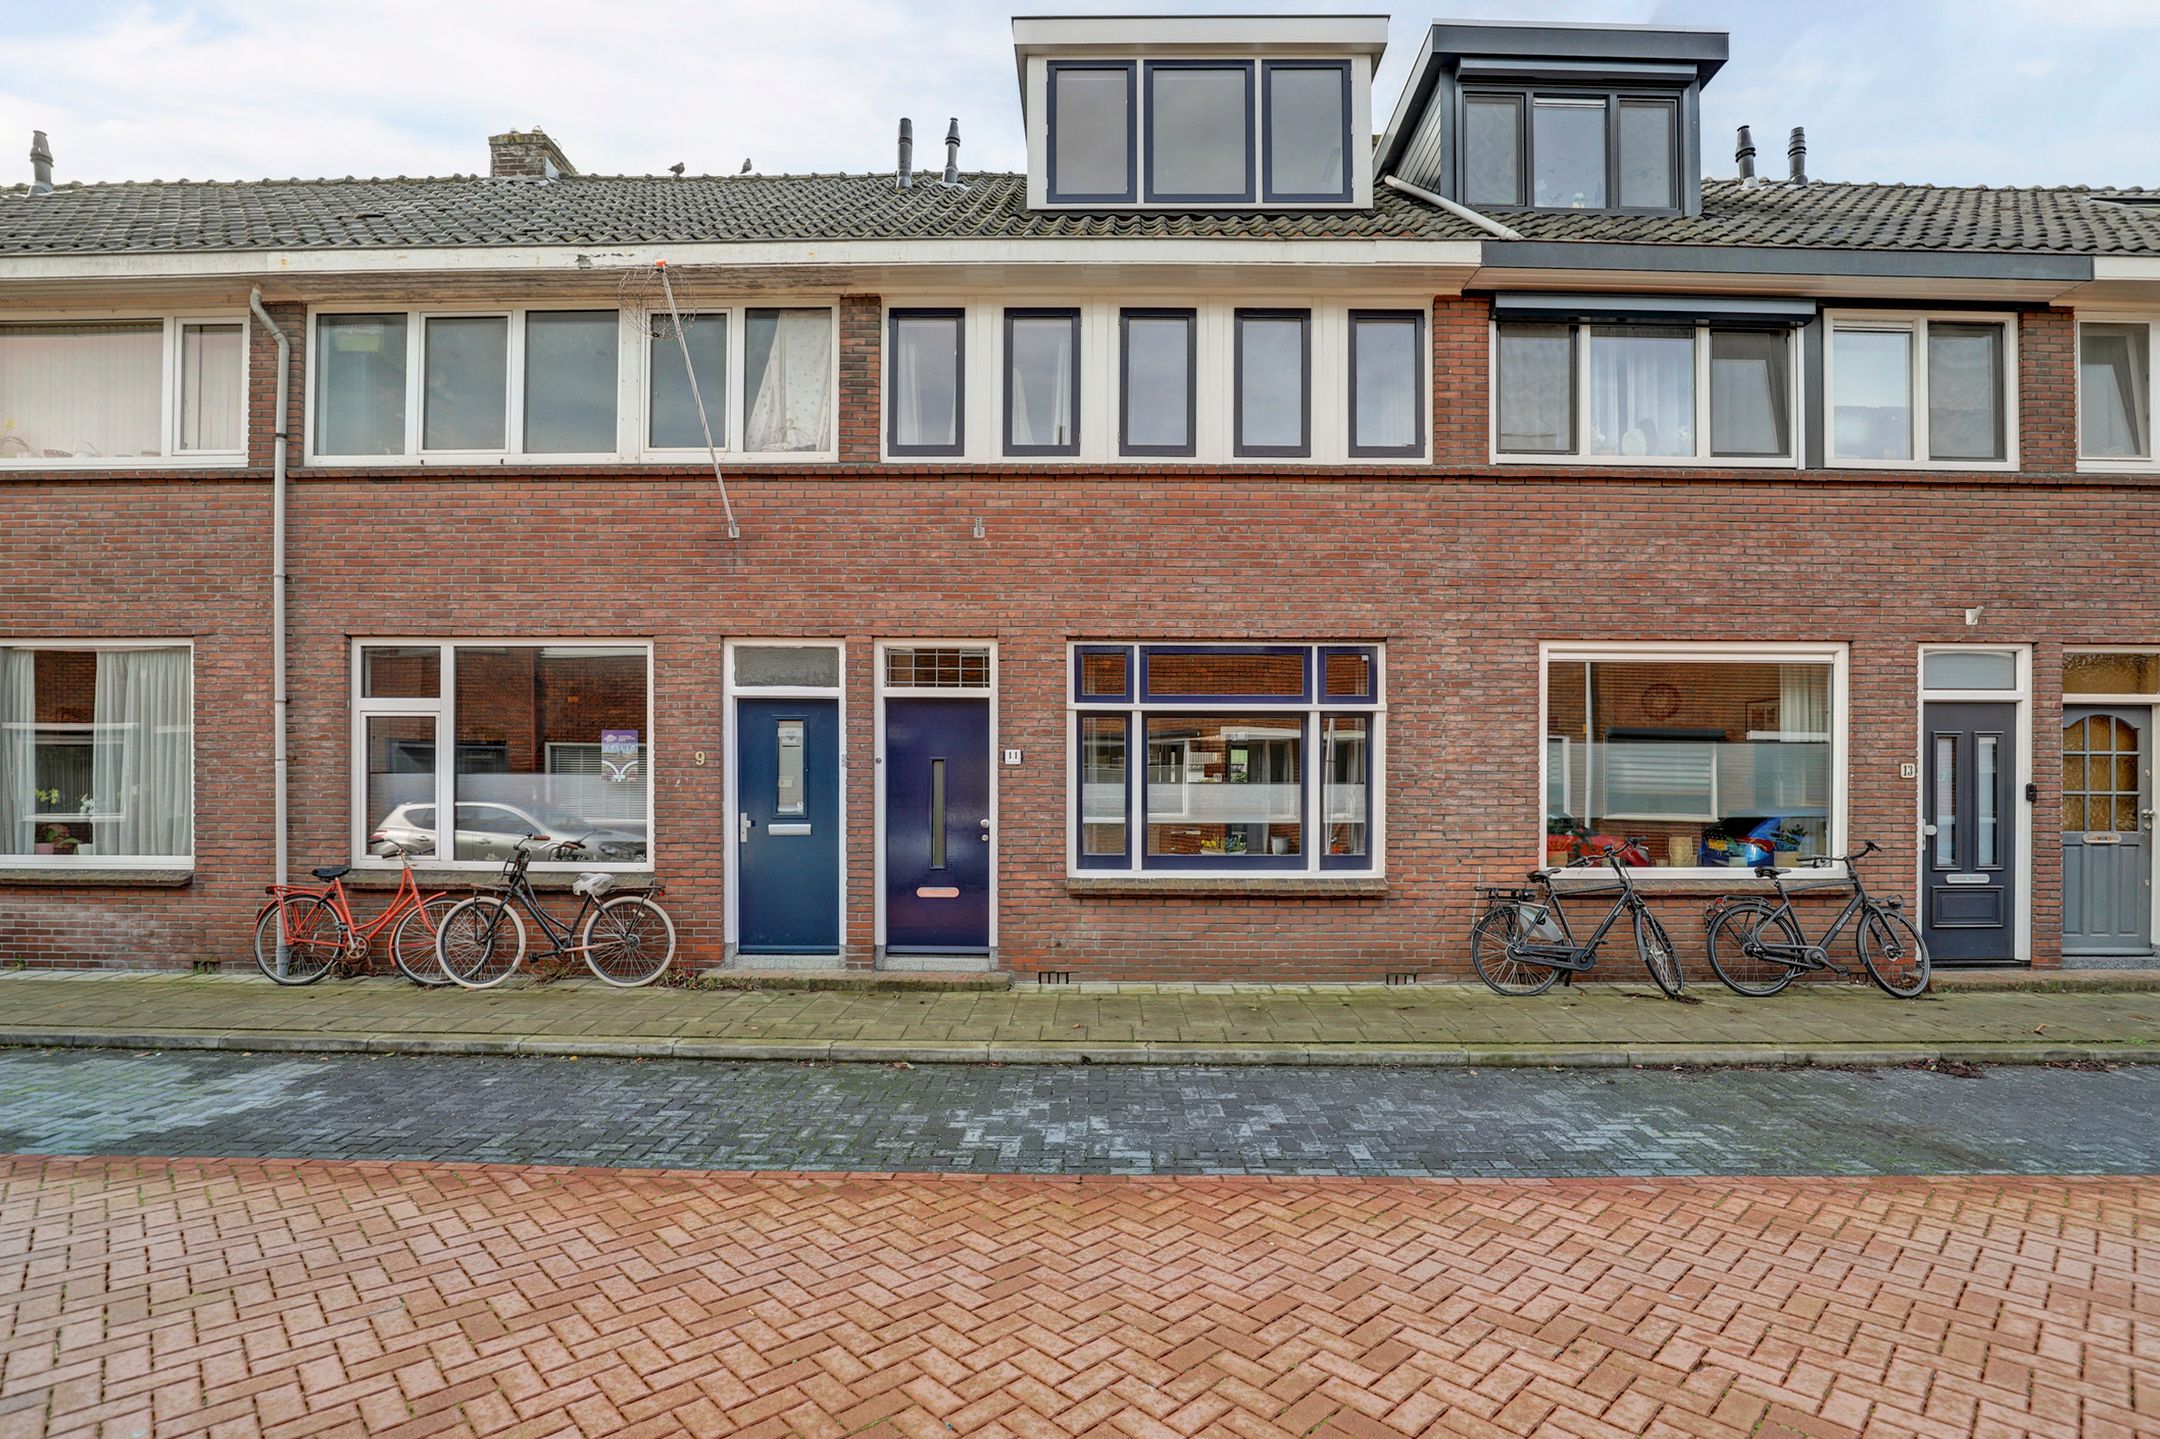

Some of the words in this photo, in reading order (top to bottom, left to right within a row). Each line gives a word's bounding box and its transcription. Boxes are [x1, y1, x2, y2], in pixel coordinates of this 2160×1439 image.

[694, 751, 706, 766] 9
[1008, 751, 1018, 760] 11
[1903, 765, 1913, 777] 13
